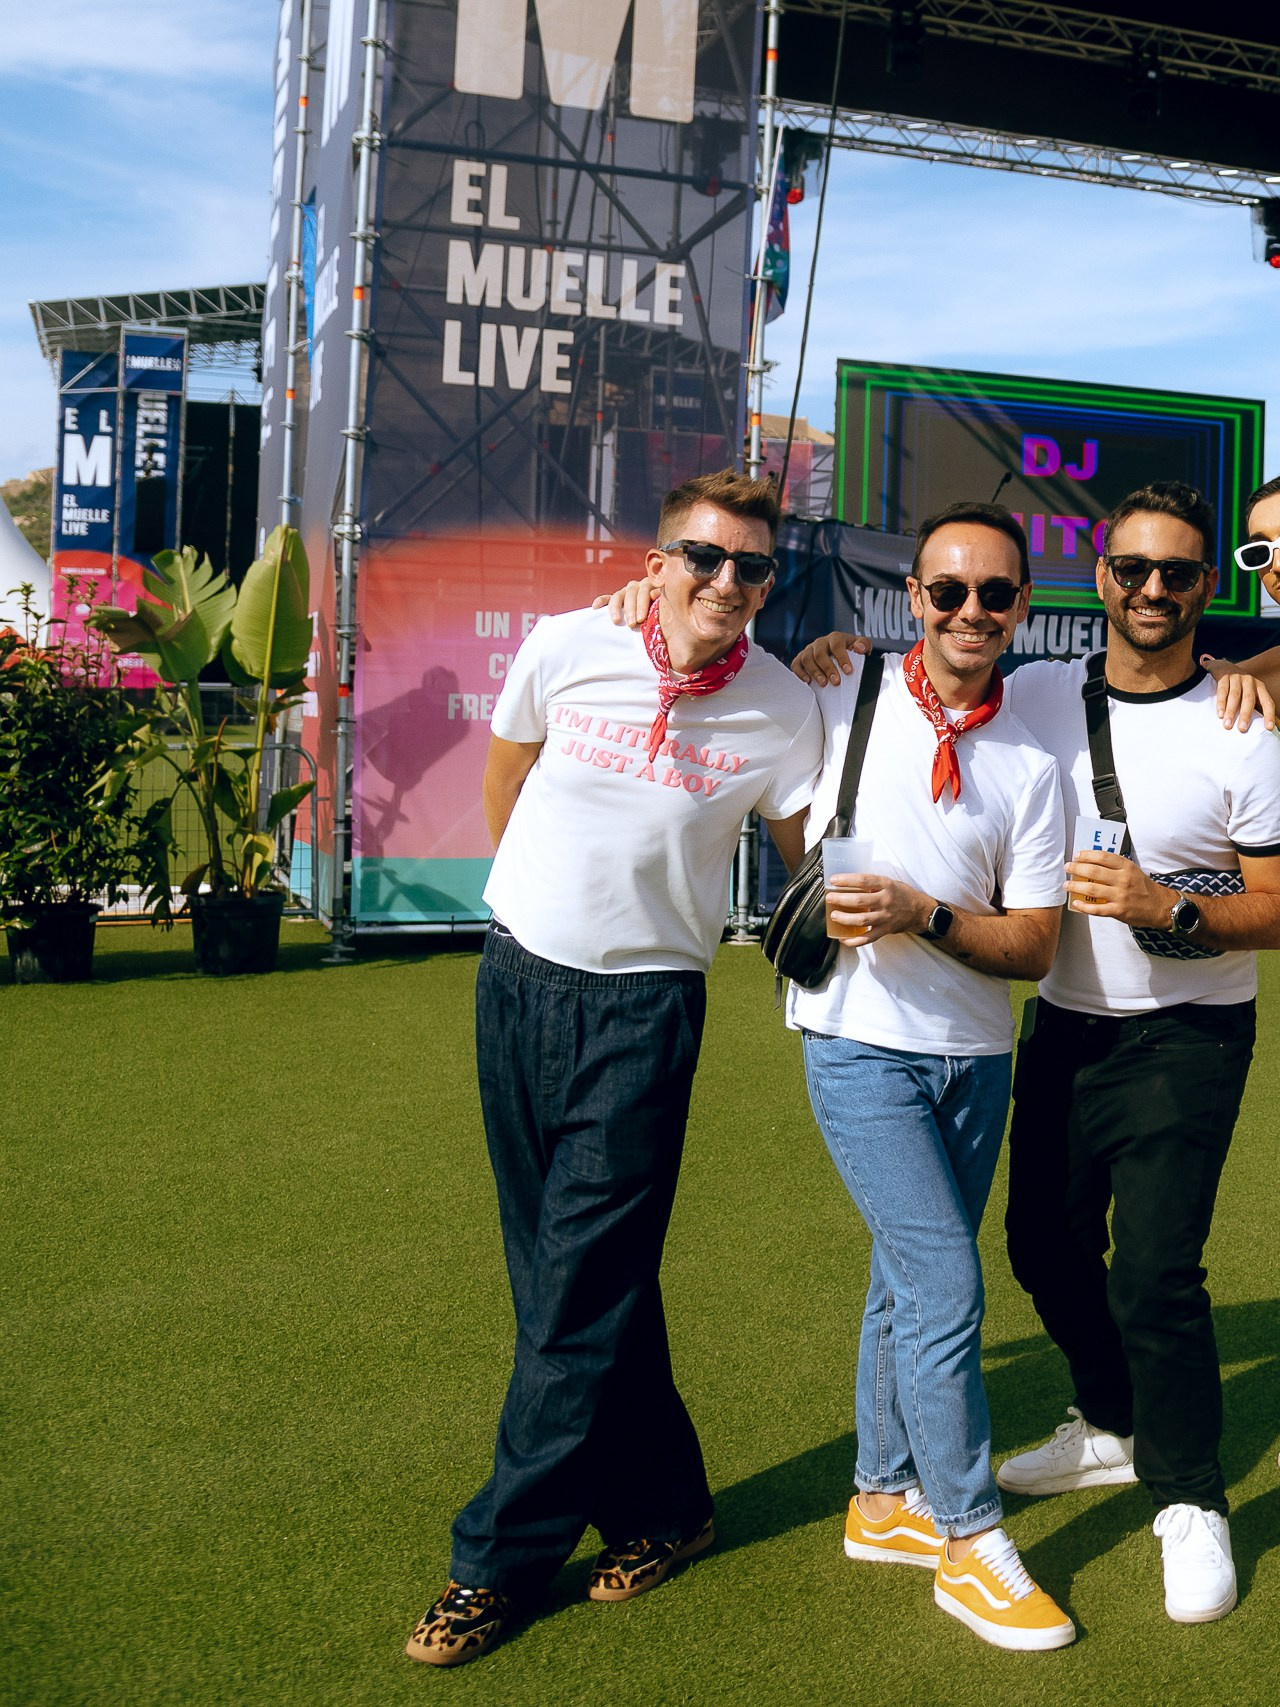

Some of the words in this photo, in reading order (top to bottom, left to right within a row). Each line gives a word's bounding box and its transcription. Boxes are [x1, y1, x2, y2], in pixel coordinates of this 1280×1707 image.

[449, 159, 521, 231] EL
[446, 239, 686, 326] MUELLE
[442, 319, 574, 393] LIVE
[62, 433, 112, 487] M
[1021, 433, 1099, 482] DJ
[61, 508, 110, 523] MUELLE
[62, 493, 78, 508] EL
[61, 521, 89, 536] LIVE
[475, 611, 510, 638] UN
[554, 705, 593, 733] I'M
[560, 738, 634, 774] JUST
[635, 761, 656, 782] A
[662, 767, 721, 797] BOY
[1094, 830, 1102, 843] E
